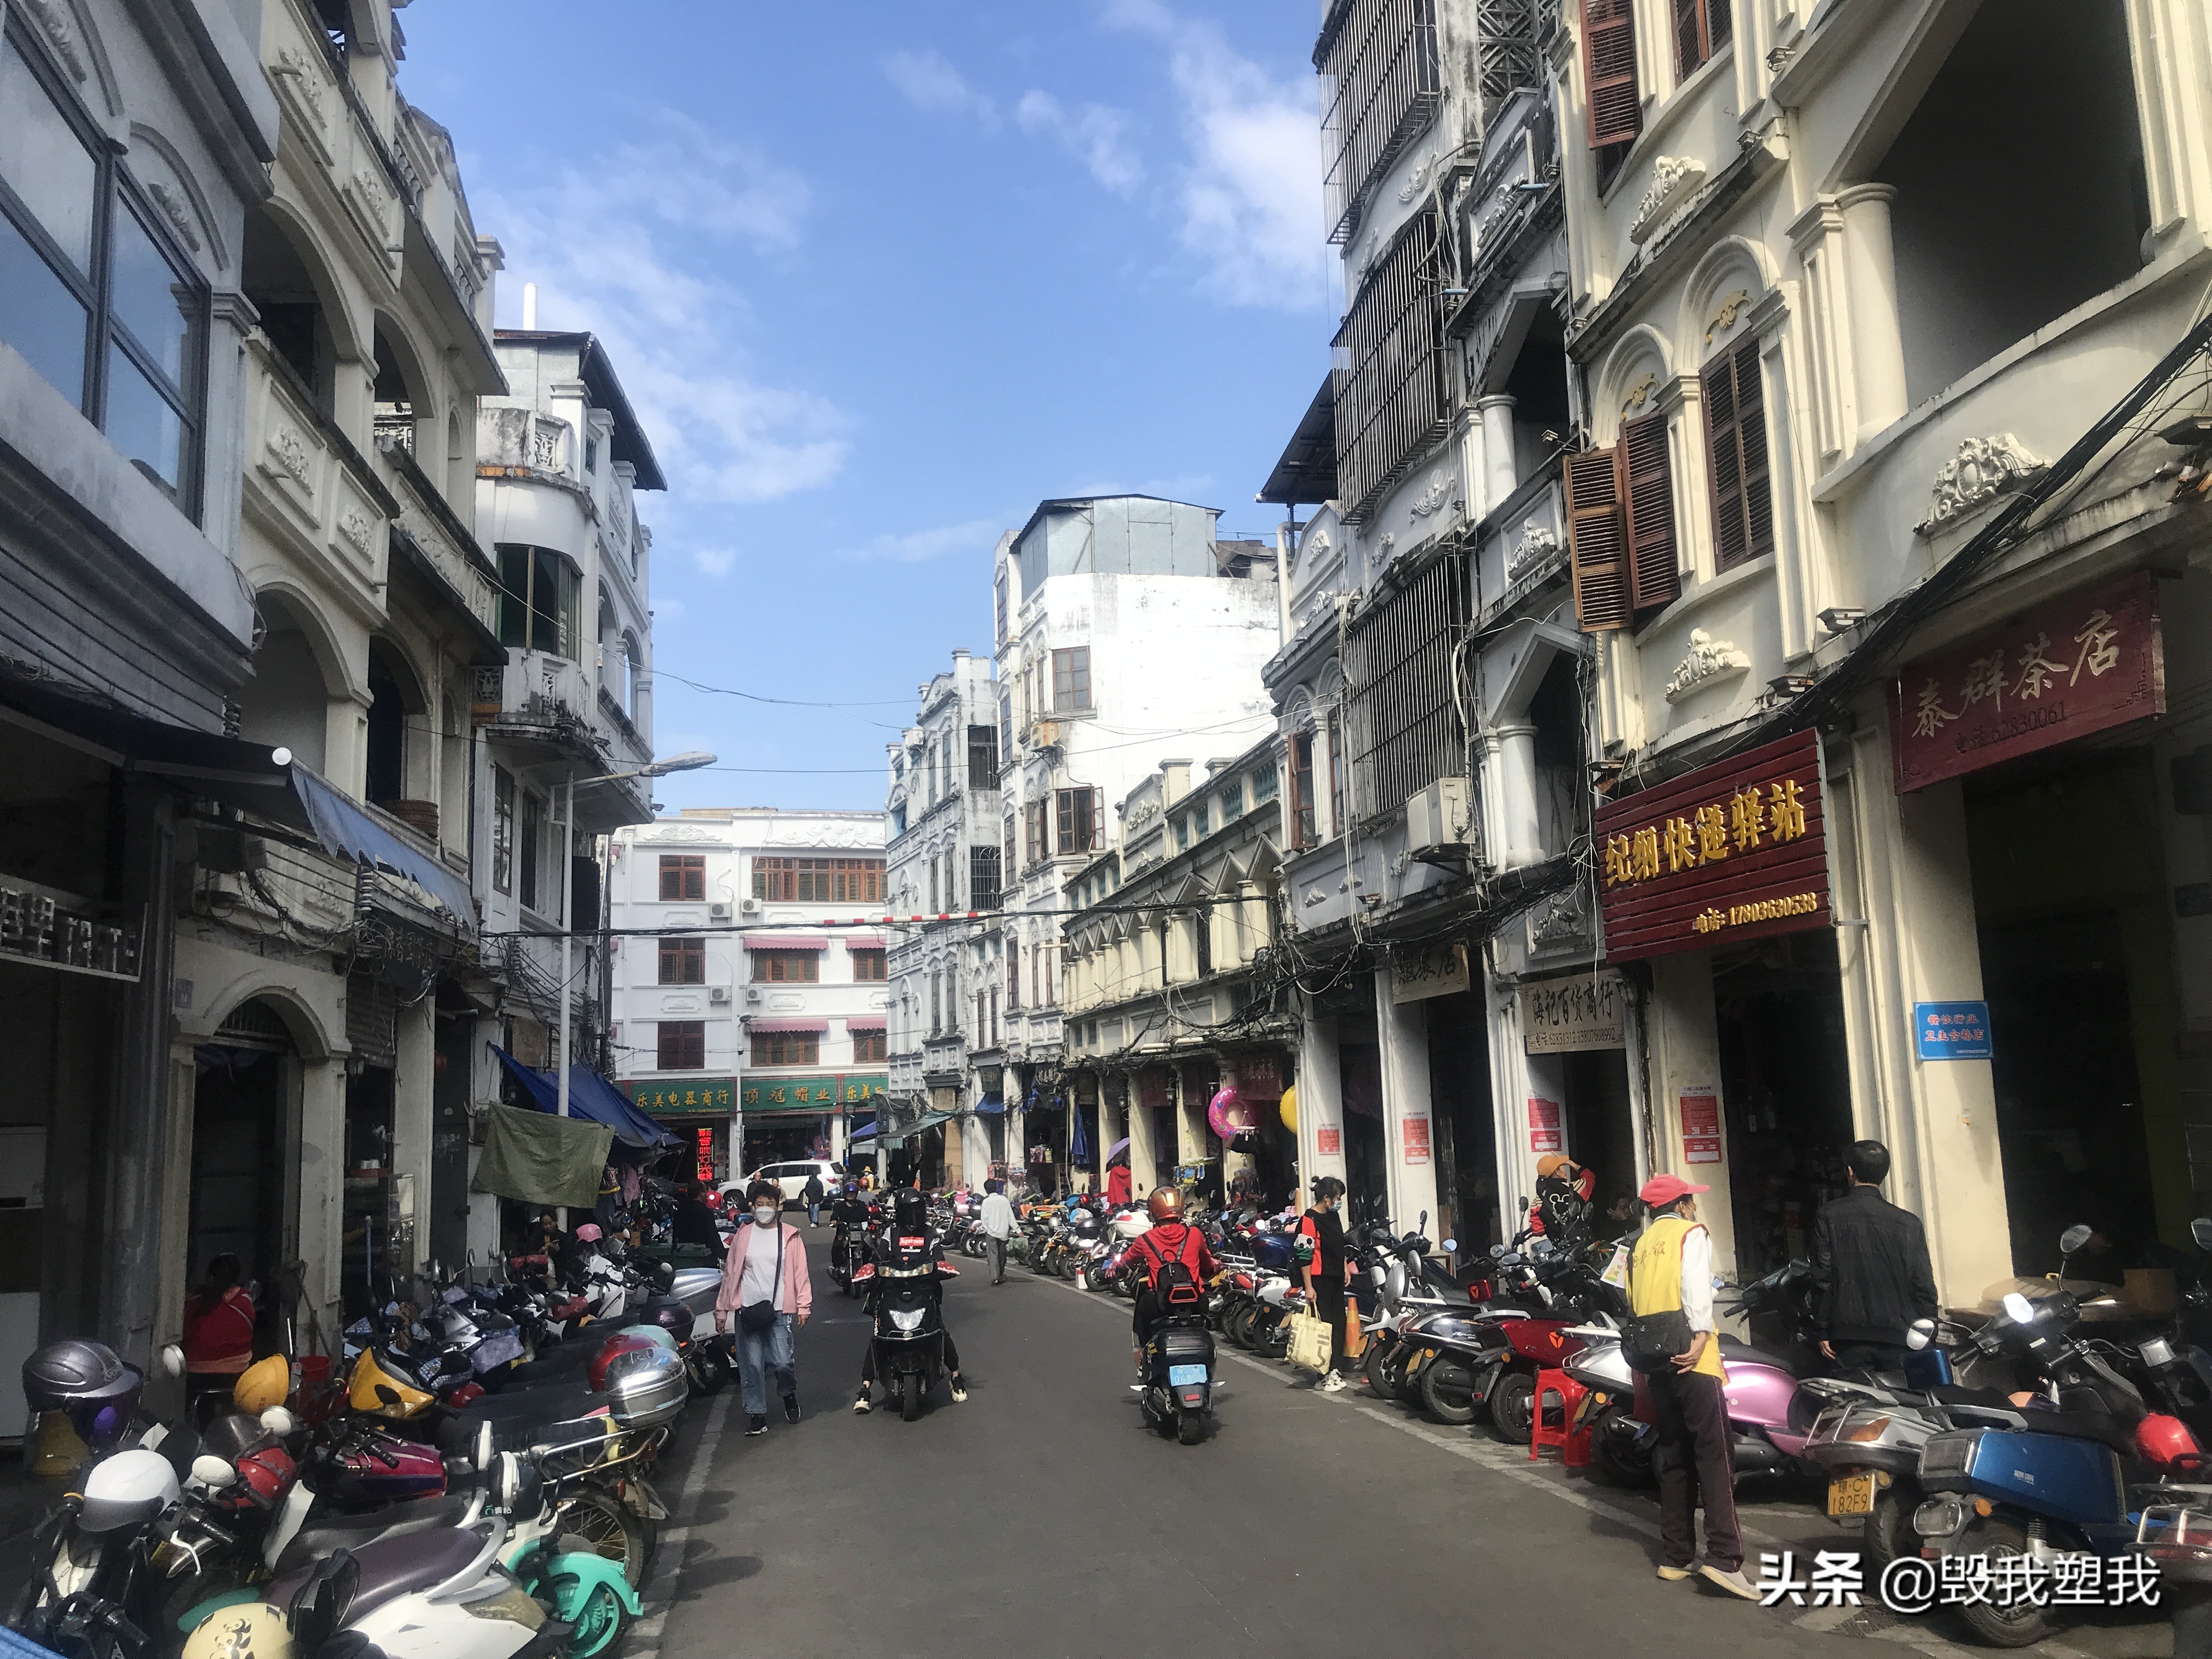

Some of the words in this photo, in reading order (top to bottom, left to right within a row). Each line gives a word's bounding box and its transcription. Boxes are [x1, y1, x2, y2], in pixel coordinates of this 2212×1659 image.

[1912, 608, 2121, 738] 泰群茶店
[1605, 779, 1807, 887] 纪纲快递驿站
[1729, 892, 1818, 926] 17803630538
[1928, 1014, 1979, 1026] 餐饮行业
[1925, 1029, 1984, 1042] 卫生合格店
[636, 1089, 729, 1108] 乐美电器商行
[743, 1086, 831, 1104] 顶冠帽业
[1833, 1493, 1868, 1515] 182F9
